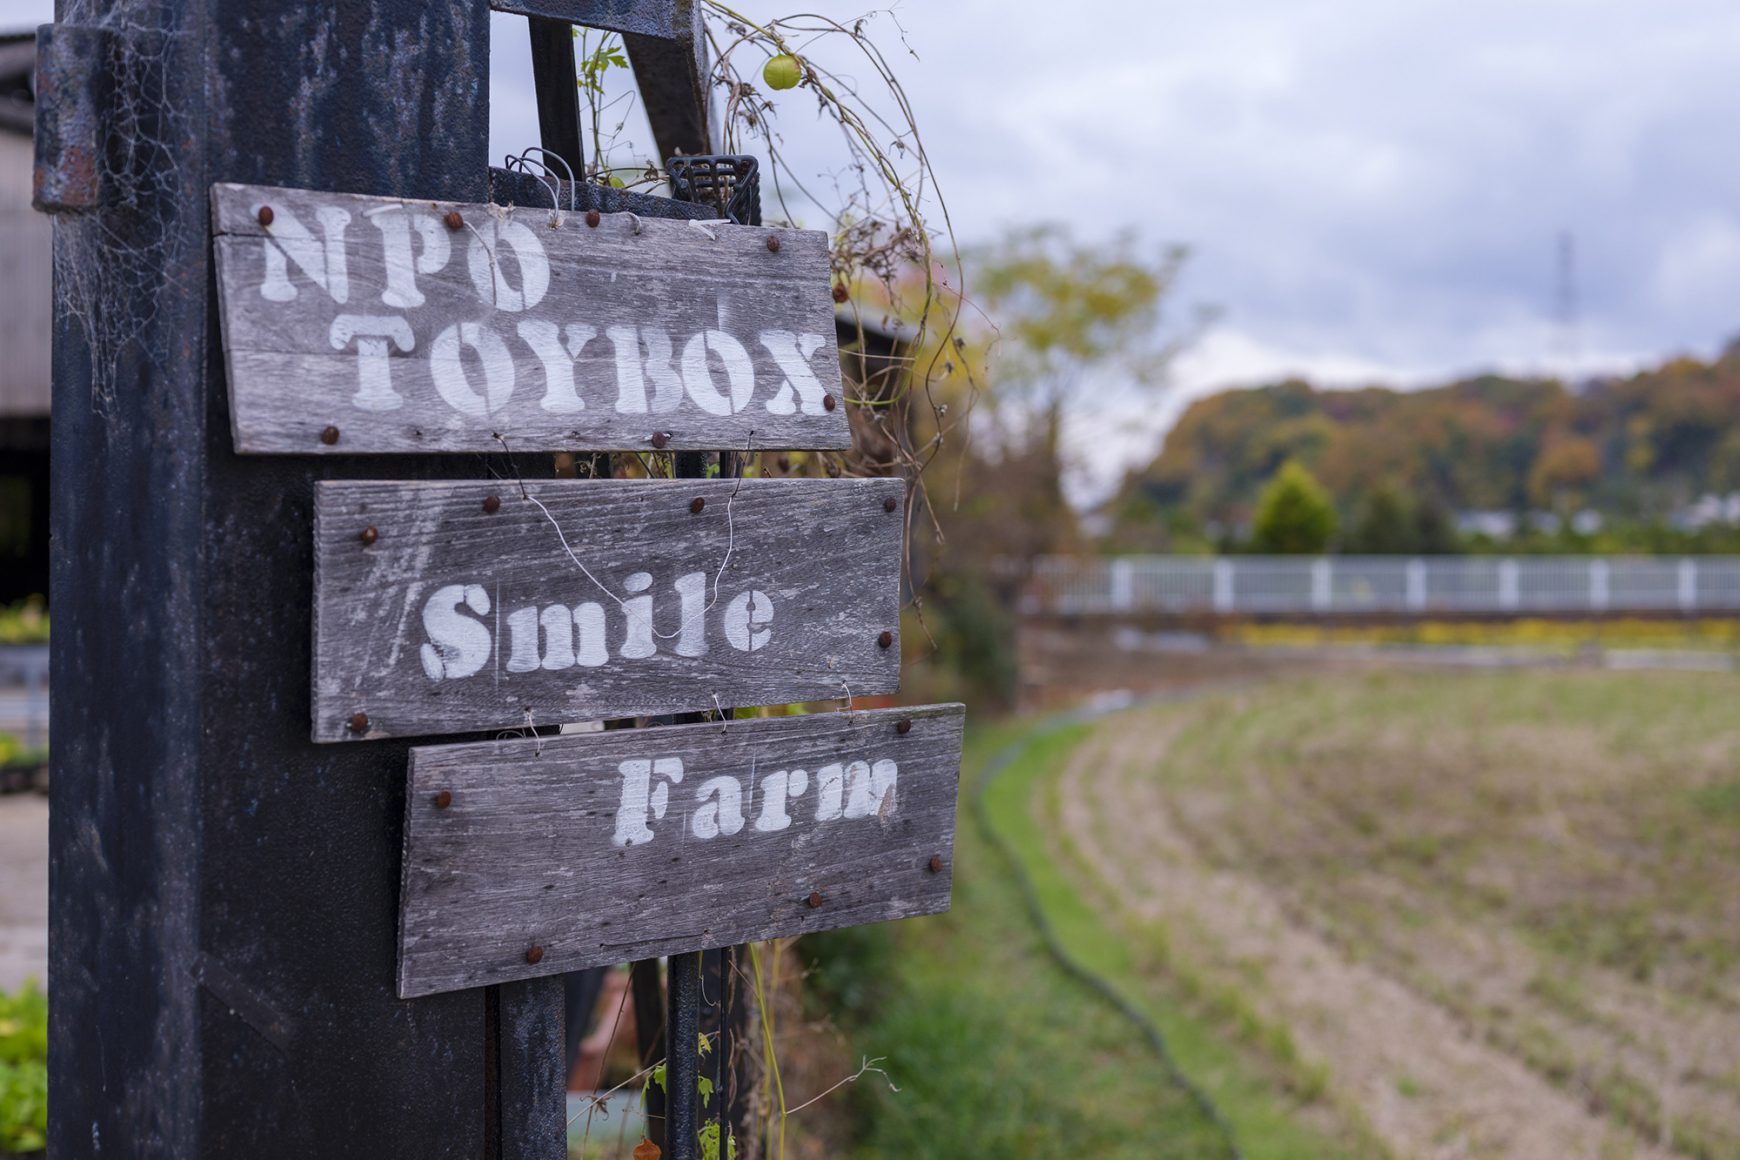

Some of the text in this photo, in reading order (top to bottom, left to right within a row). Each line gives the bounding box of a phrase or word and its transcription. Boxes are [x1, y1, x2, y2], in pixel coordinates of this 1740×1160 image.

[255, 204, 550, 311] NPO
[329, 314, 831, 417] TOYBOX
[420, 571, 775, 681] Smile
[611, 757, 898, 846] Farm
